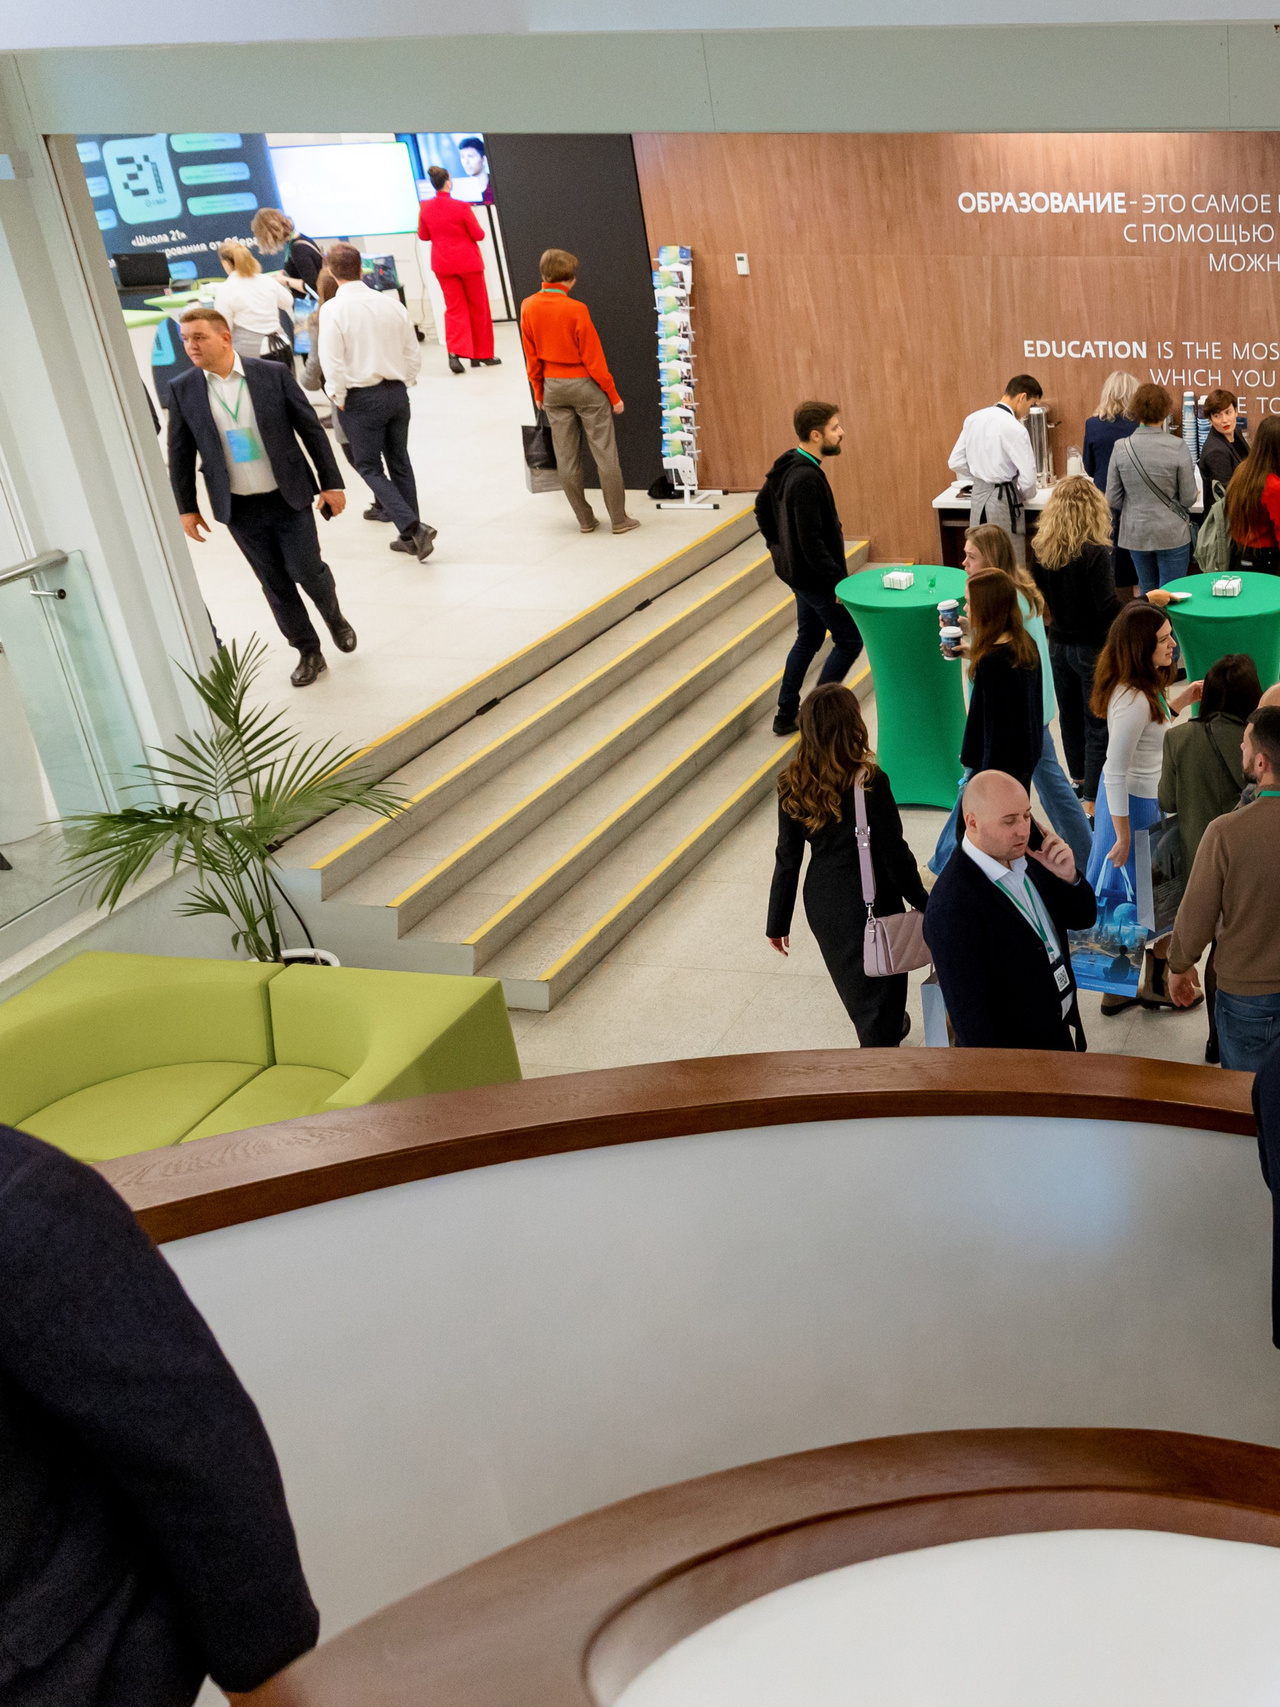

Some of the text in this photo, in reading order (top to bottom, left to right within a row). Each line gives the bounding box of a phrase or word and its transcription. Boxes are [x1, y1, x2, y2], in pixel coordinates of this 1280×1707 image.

[957, 191, 1127, 214] ОБРАЗОВАНИЕ
[1141, 193, 1187, 214] ЭТО
[1191, 193, 1272, 214] САМОЕ
[1123, 223, 1138, 243] С
[1142, 223, 1275, 246] ПОМОЩЬЮ
[156, 243, 208, 259] рования
[1023, 339, 1147, 359] EDUCATION
[1157, 341, 1174, 360] IS
[1181, 341, 1222, 360] THE
[1149, 368, 1222, 387] WHICH
[1231, 369, 1276, 388] YOU
